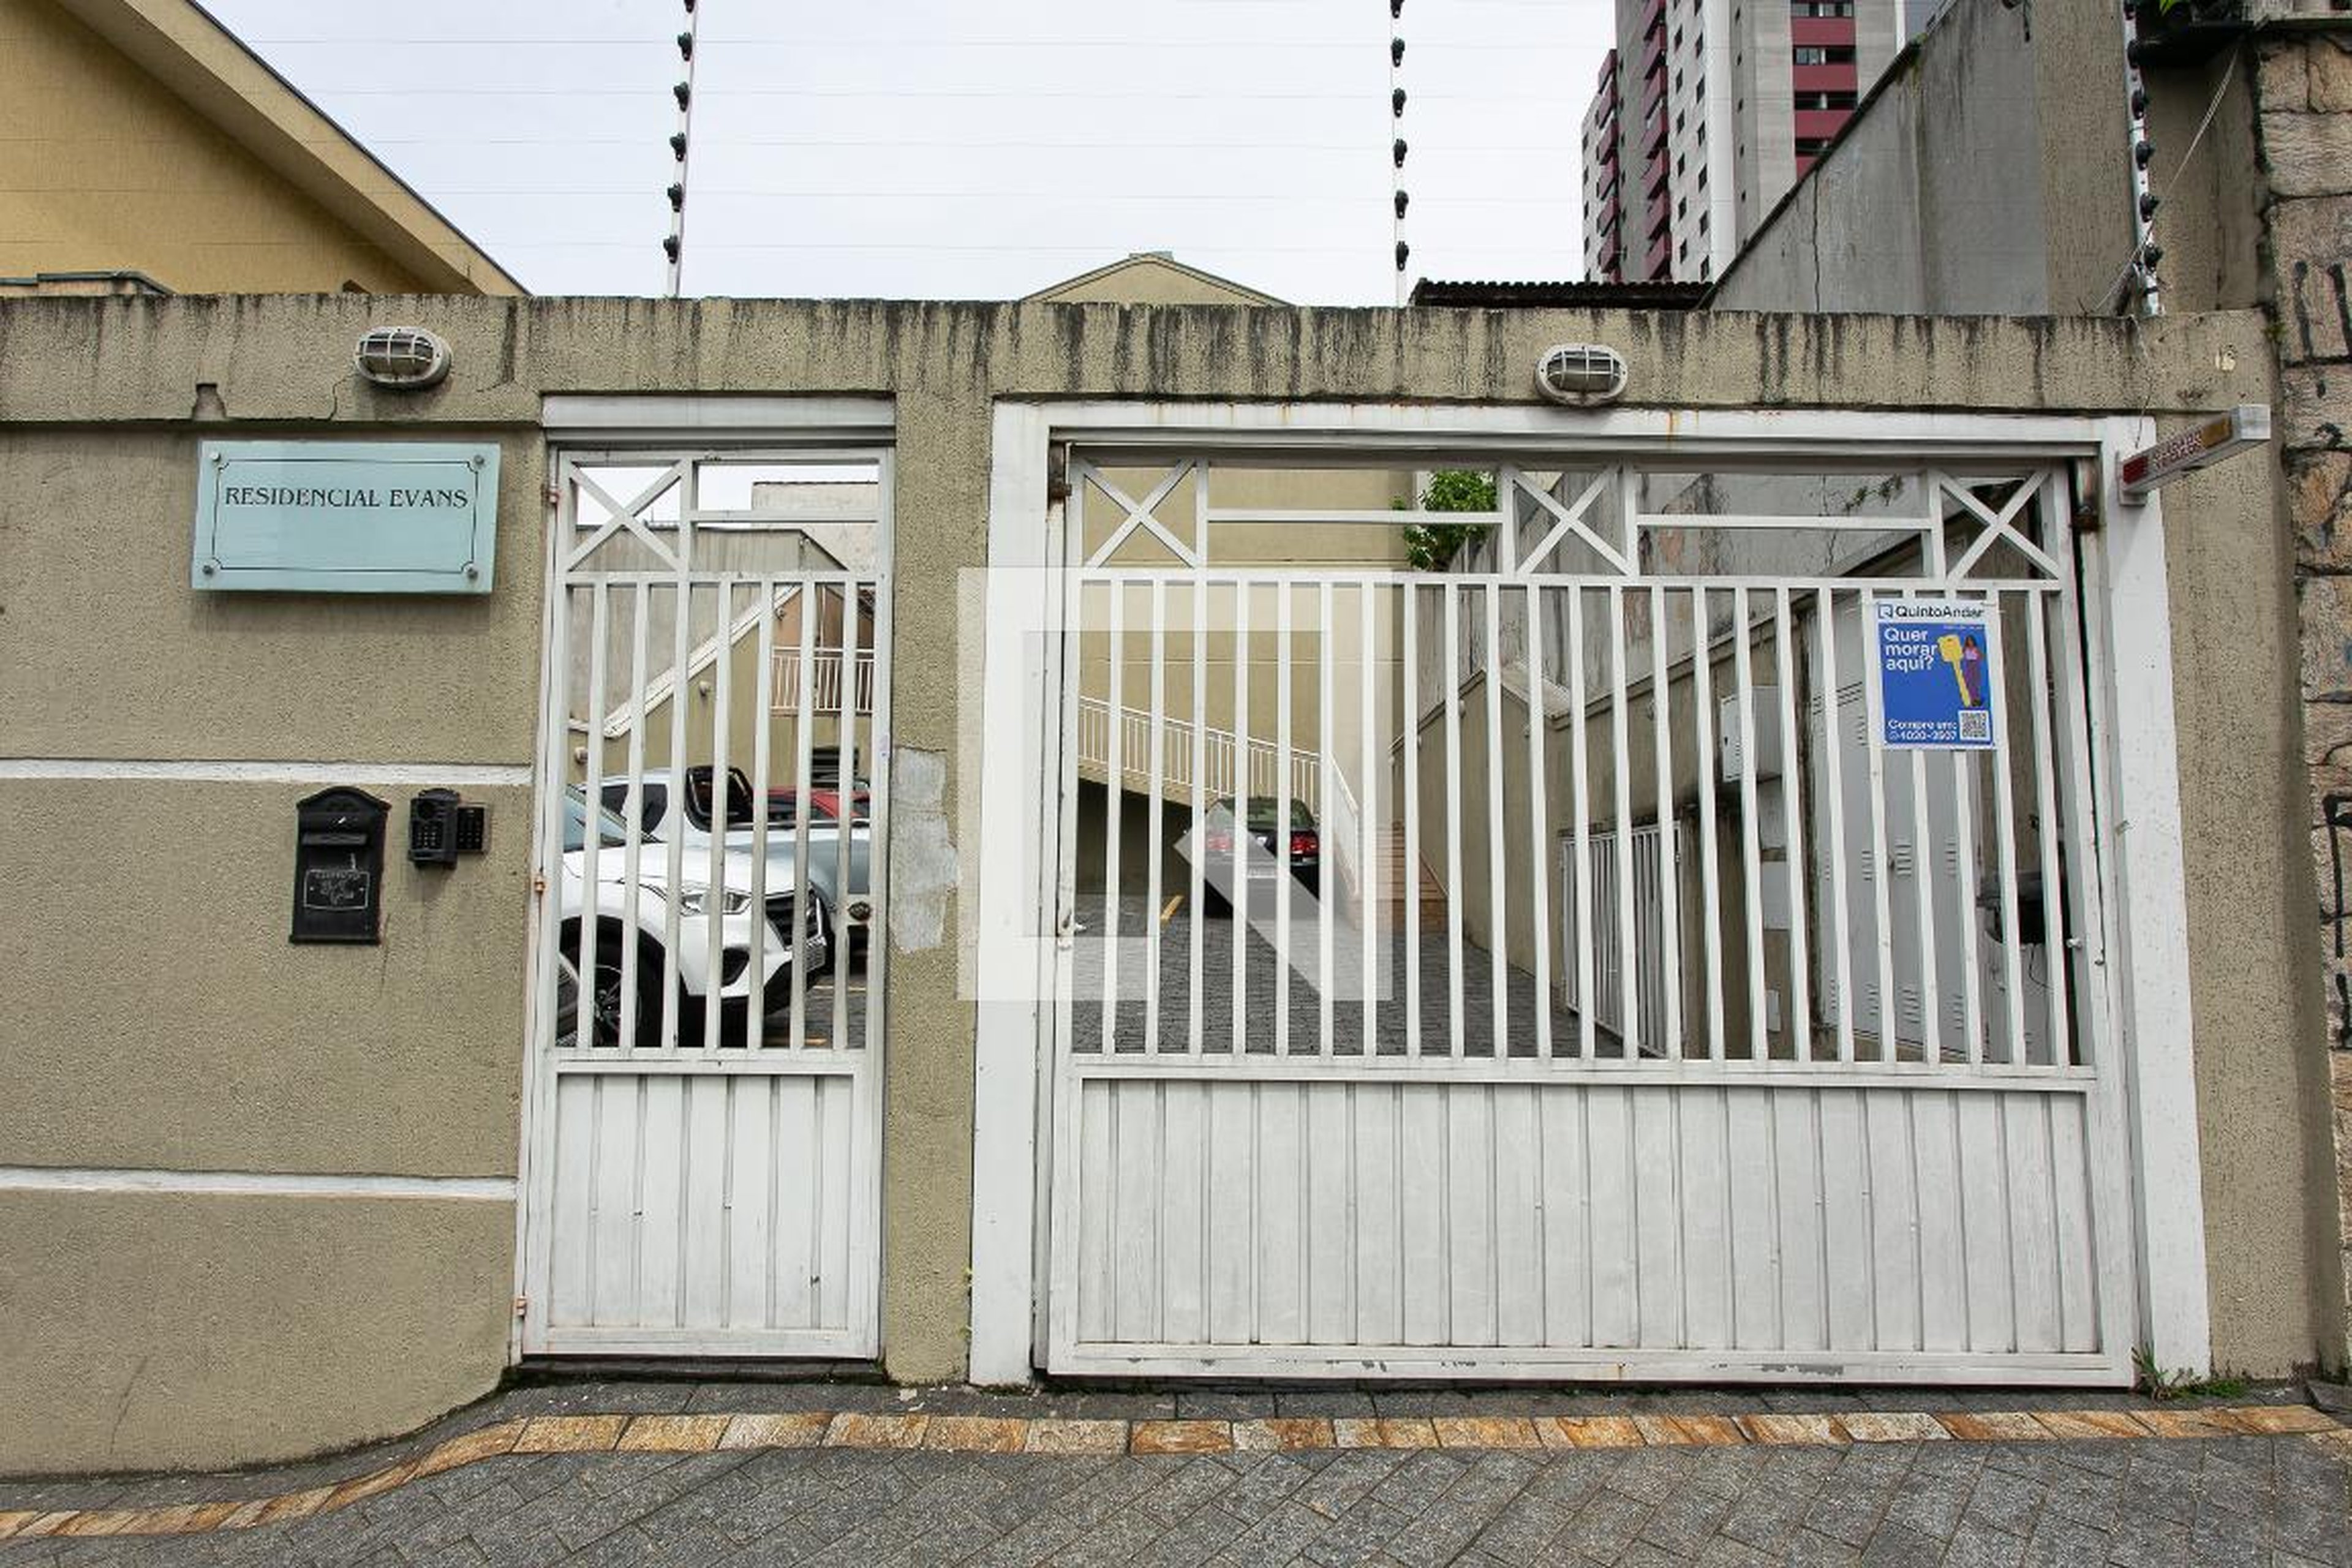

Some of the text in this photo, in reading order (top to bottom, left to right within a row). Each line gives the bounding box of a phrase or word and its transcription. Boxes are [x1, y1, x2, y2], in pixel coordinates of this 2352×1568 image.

[225, 488, 469, 508] RESIDENCIAL EVANS
[1896, 606, 1984, 617] QuintoAndar
[1884, 628, 1928, 642] Quer
[1886, 644, 1937, 655] morar
[1886, 655, 1934, 673] aqui?
[1888, 720, 1934, 729] Compre
